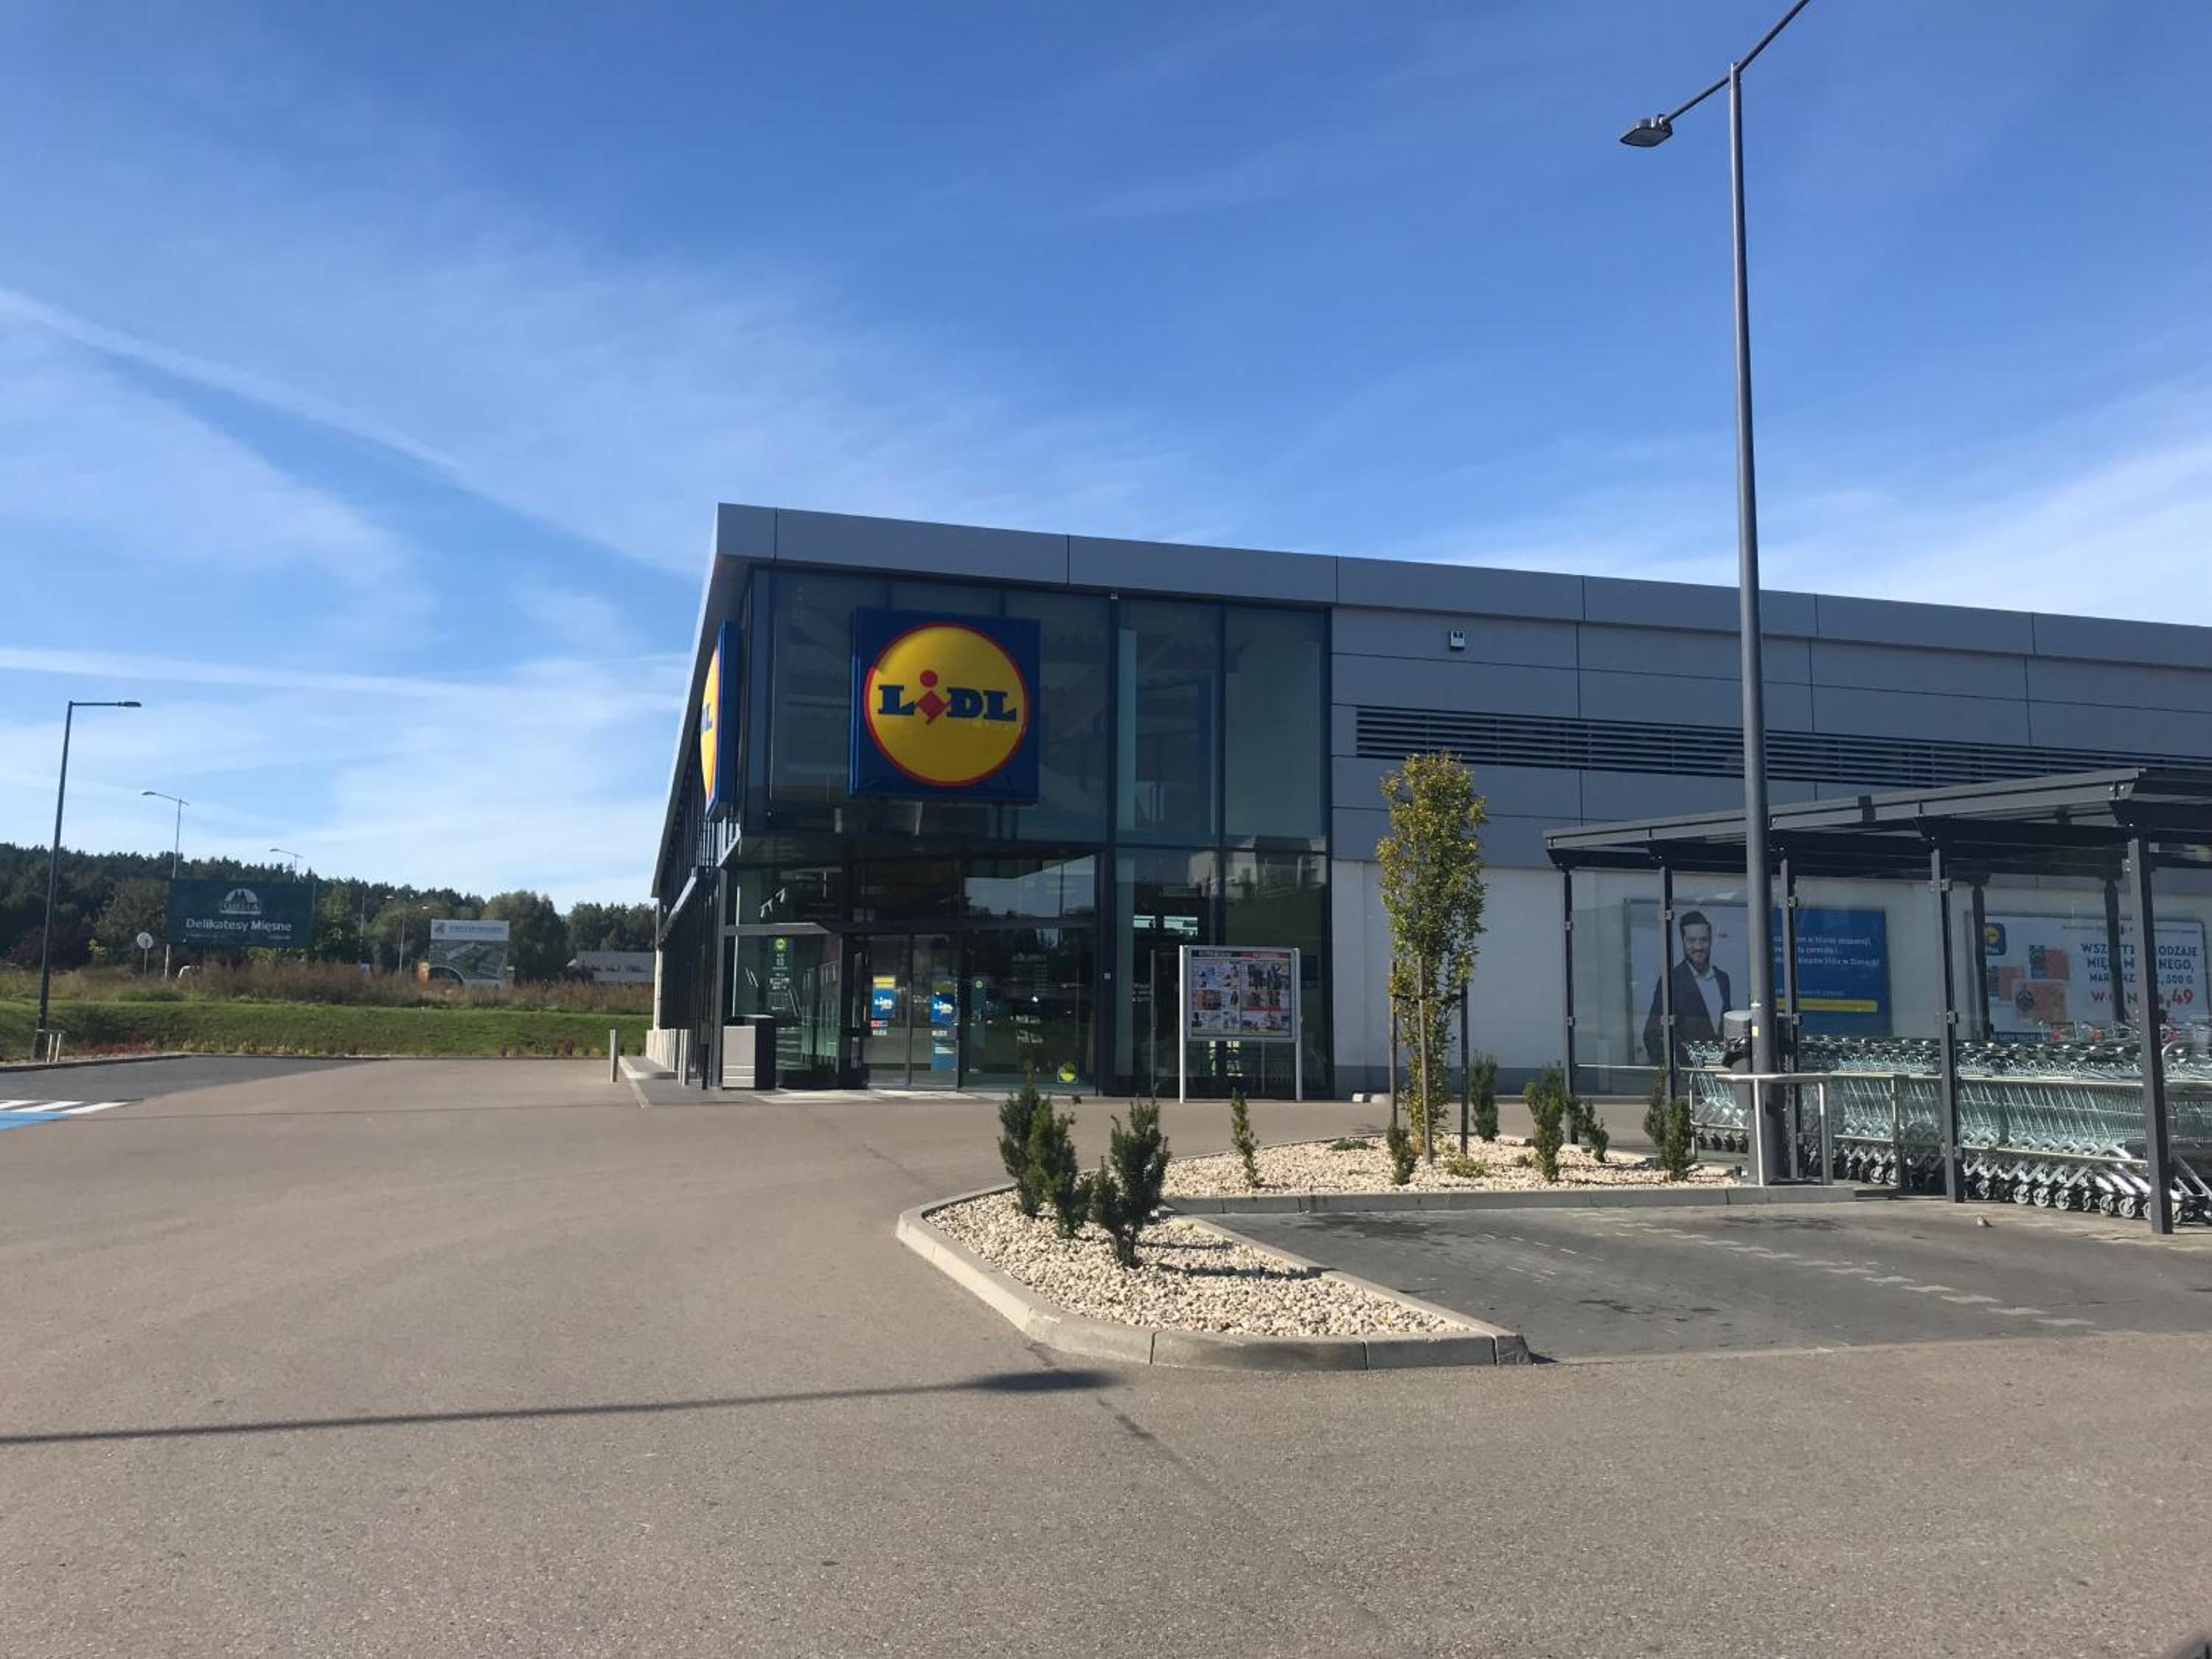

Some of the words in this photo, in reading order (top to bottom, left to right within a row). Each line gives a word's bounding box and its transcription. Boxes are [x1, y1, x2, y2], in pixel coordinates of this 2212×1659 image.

[878, 669, 1017, 725] LIDL
[186, 918, 248, 932] Delikatesy
[2157, 946, 2198, 956] ODZAJE
